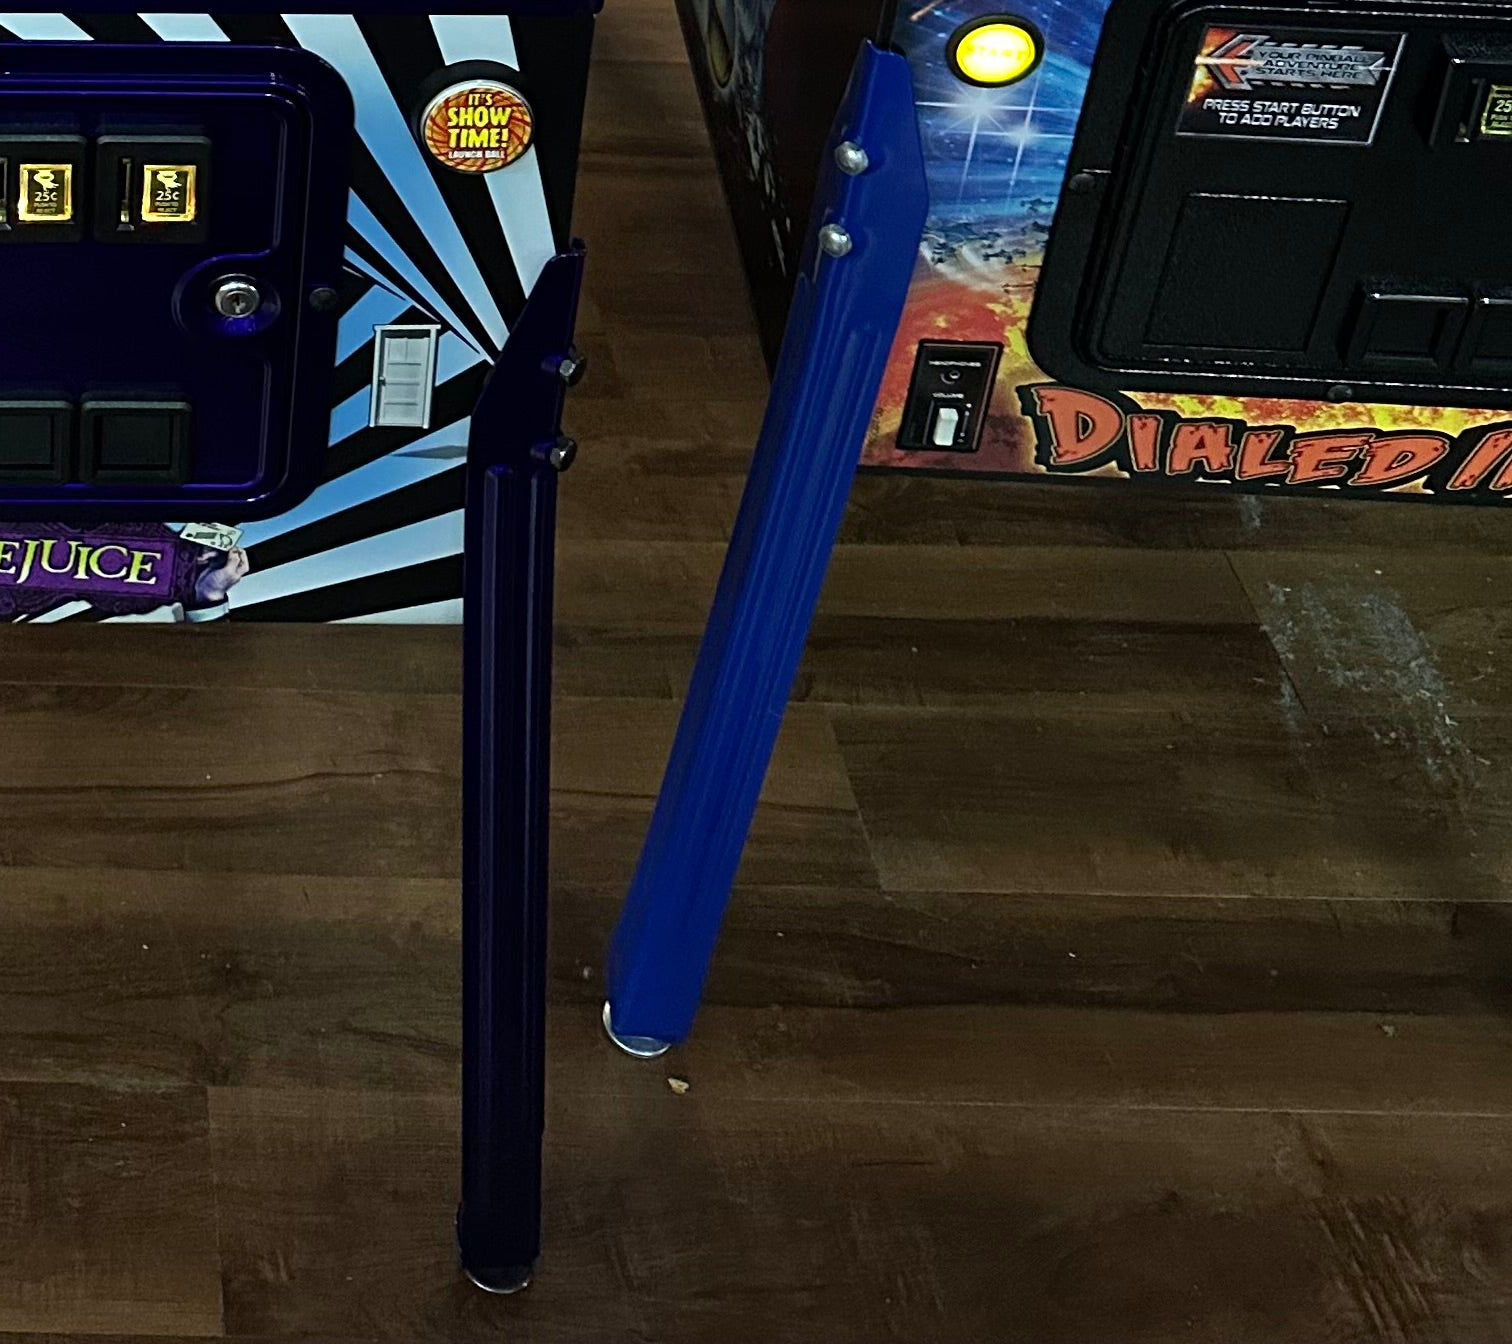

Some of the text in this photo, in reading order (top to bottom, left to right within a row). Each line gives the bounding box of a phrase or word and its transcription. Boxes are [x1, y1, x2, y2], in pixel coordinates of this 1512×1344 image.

[1259, 50, 1371, 63] YOUR PINBALL
[1256, 67, 1361, 79] STARTS HERE
[1263, 60, 1361, 71] ADVENTURE
[469, 93, 494, 105] IT'S
[1203, 98, 1361, 118] PRESS START BUTTON
[448, 106, 512, 127] SHOW
[1219, 112, 1340, 130] TO ADD PLAYERS
[448, 127, 509, 148] TIME!
[448, 150, 505, 159] LAUNCH BALL
[1029, 387, 1451, 488] DIALED
